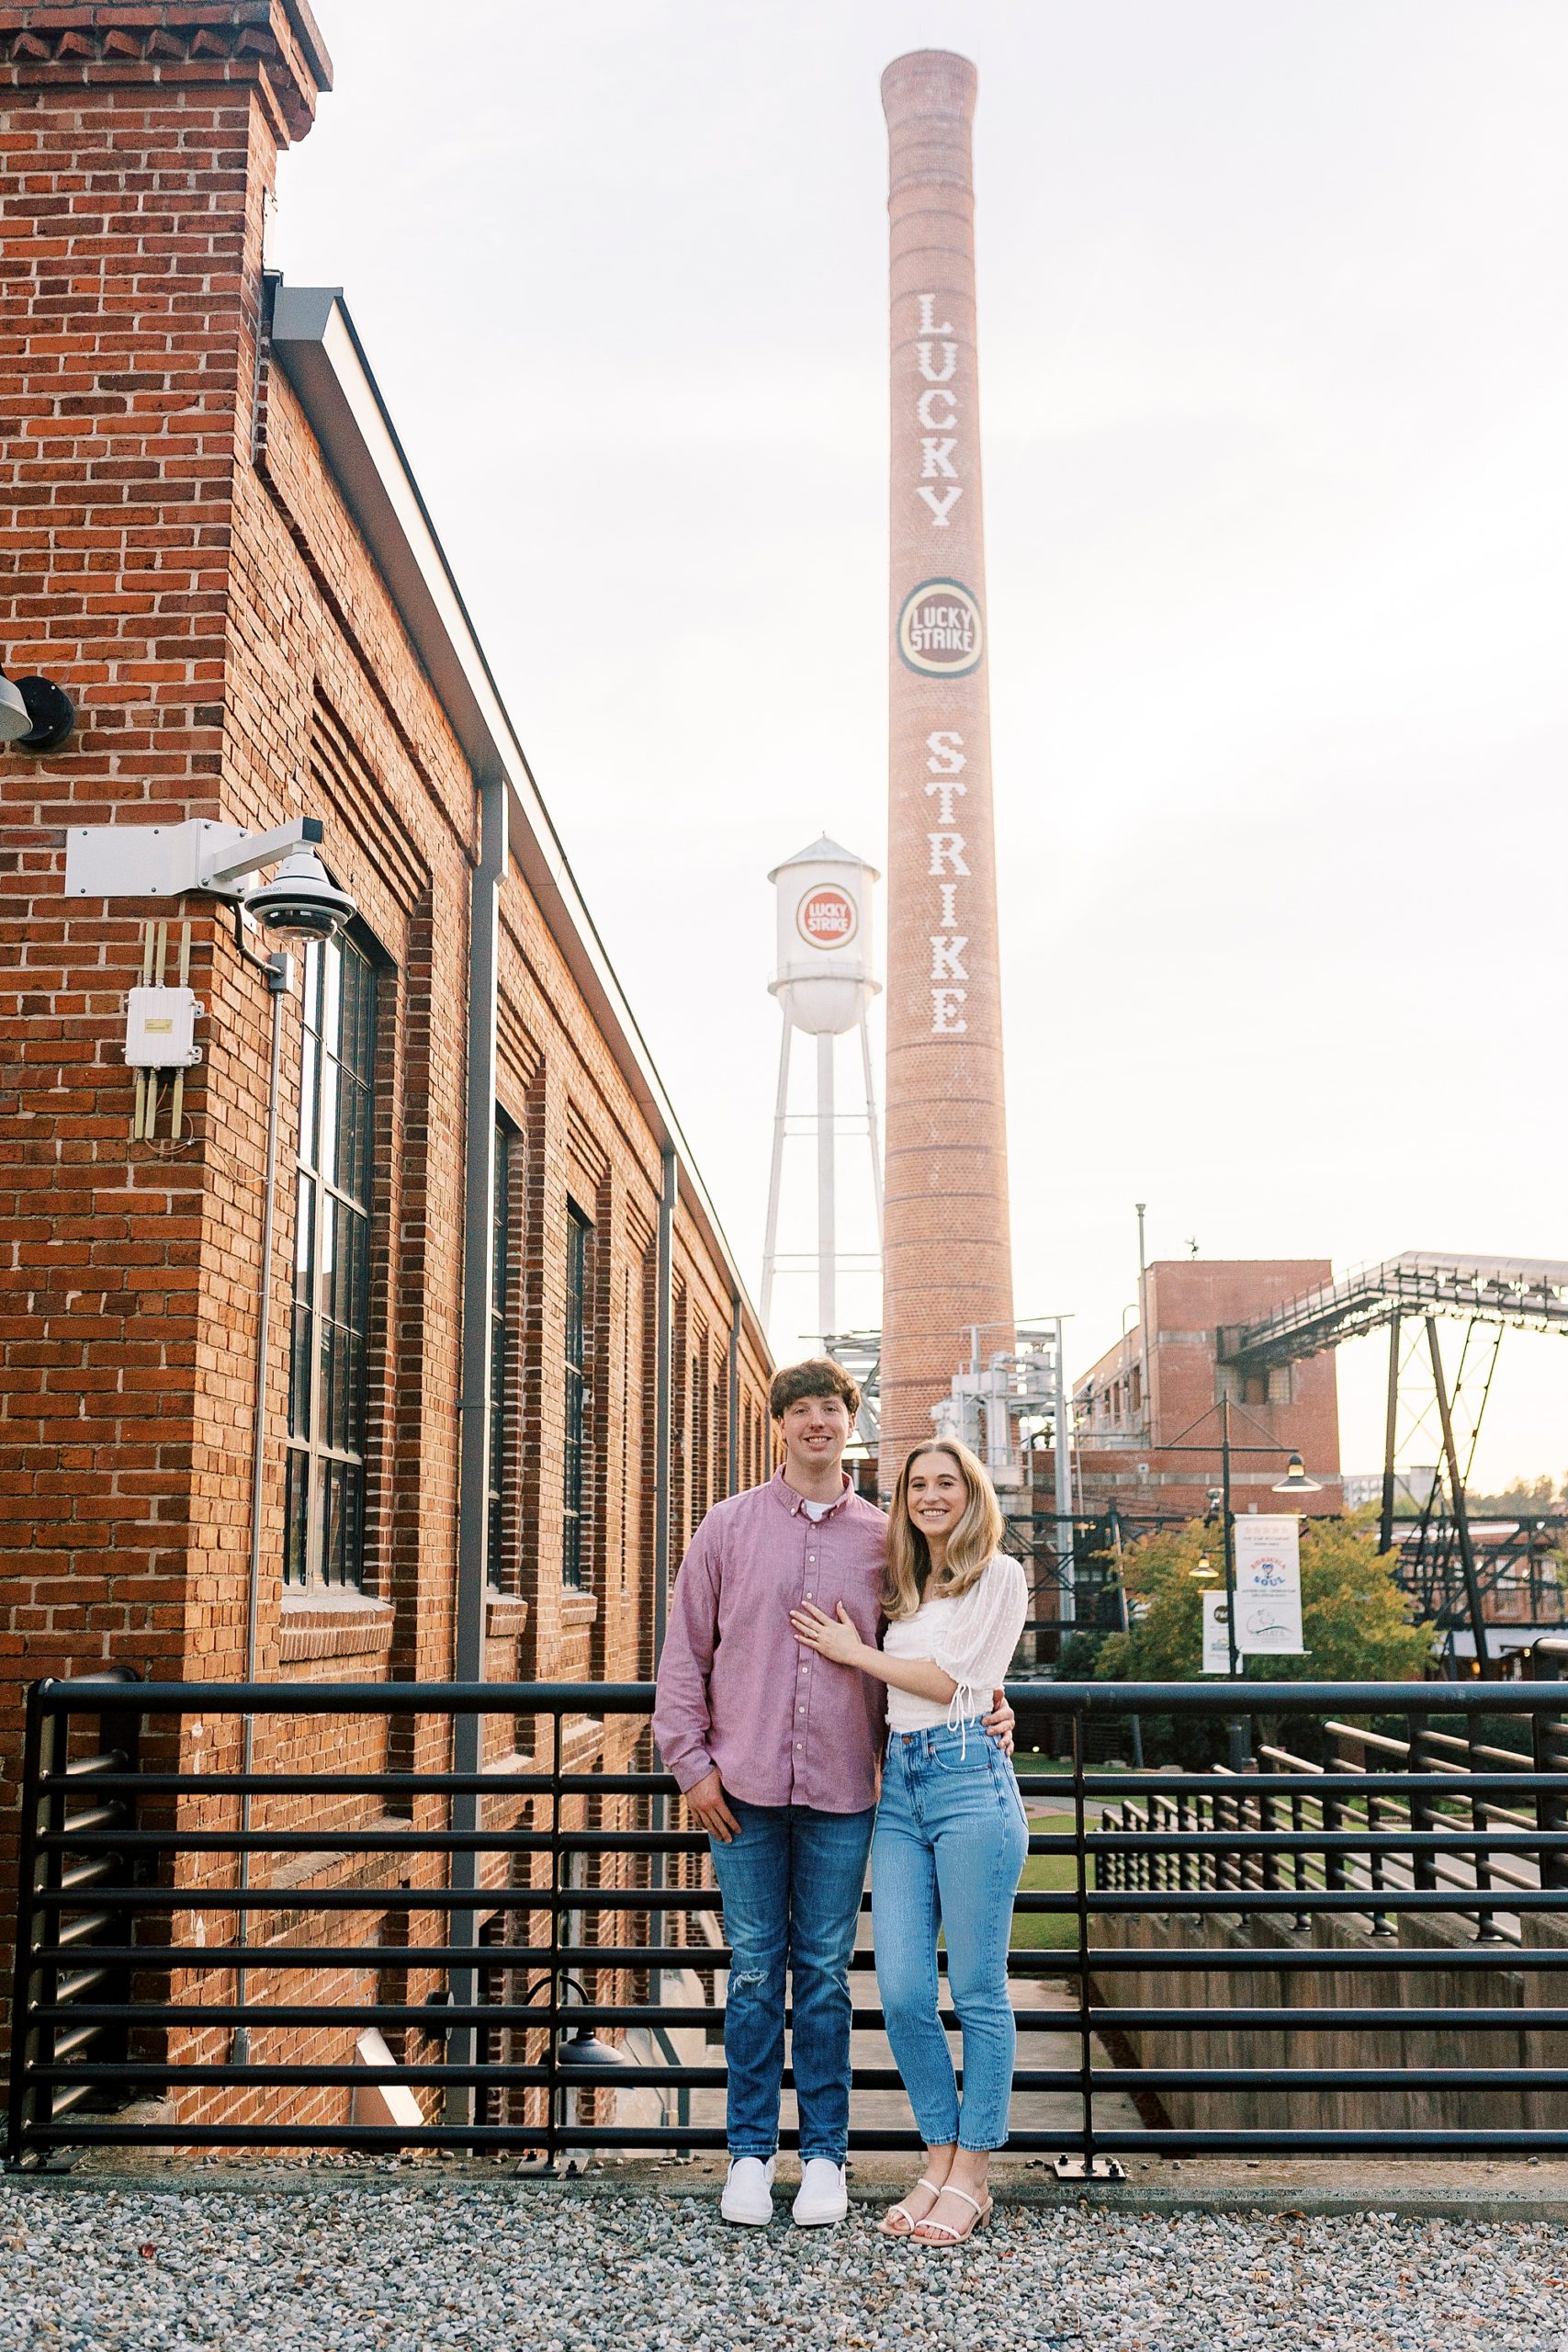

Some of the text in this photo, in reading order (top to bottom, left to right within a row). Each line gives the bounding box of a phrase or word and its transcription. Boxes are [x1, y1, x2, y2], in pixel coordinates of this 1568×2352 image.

[916, 293, 964, 526] LUCKY
[912, 606, 971, 630] LUCKY
[910, 628, 974, 652] STRIKE
[924, 730, 972, 1035] STRIKE
[808, 902, 847, 918] LUCKY
[807, 917, 849, 933] STRIKE
[1254, 1576, 1286, 1587] SOUL
